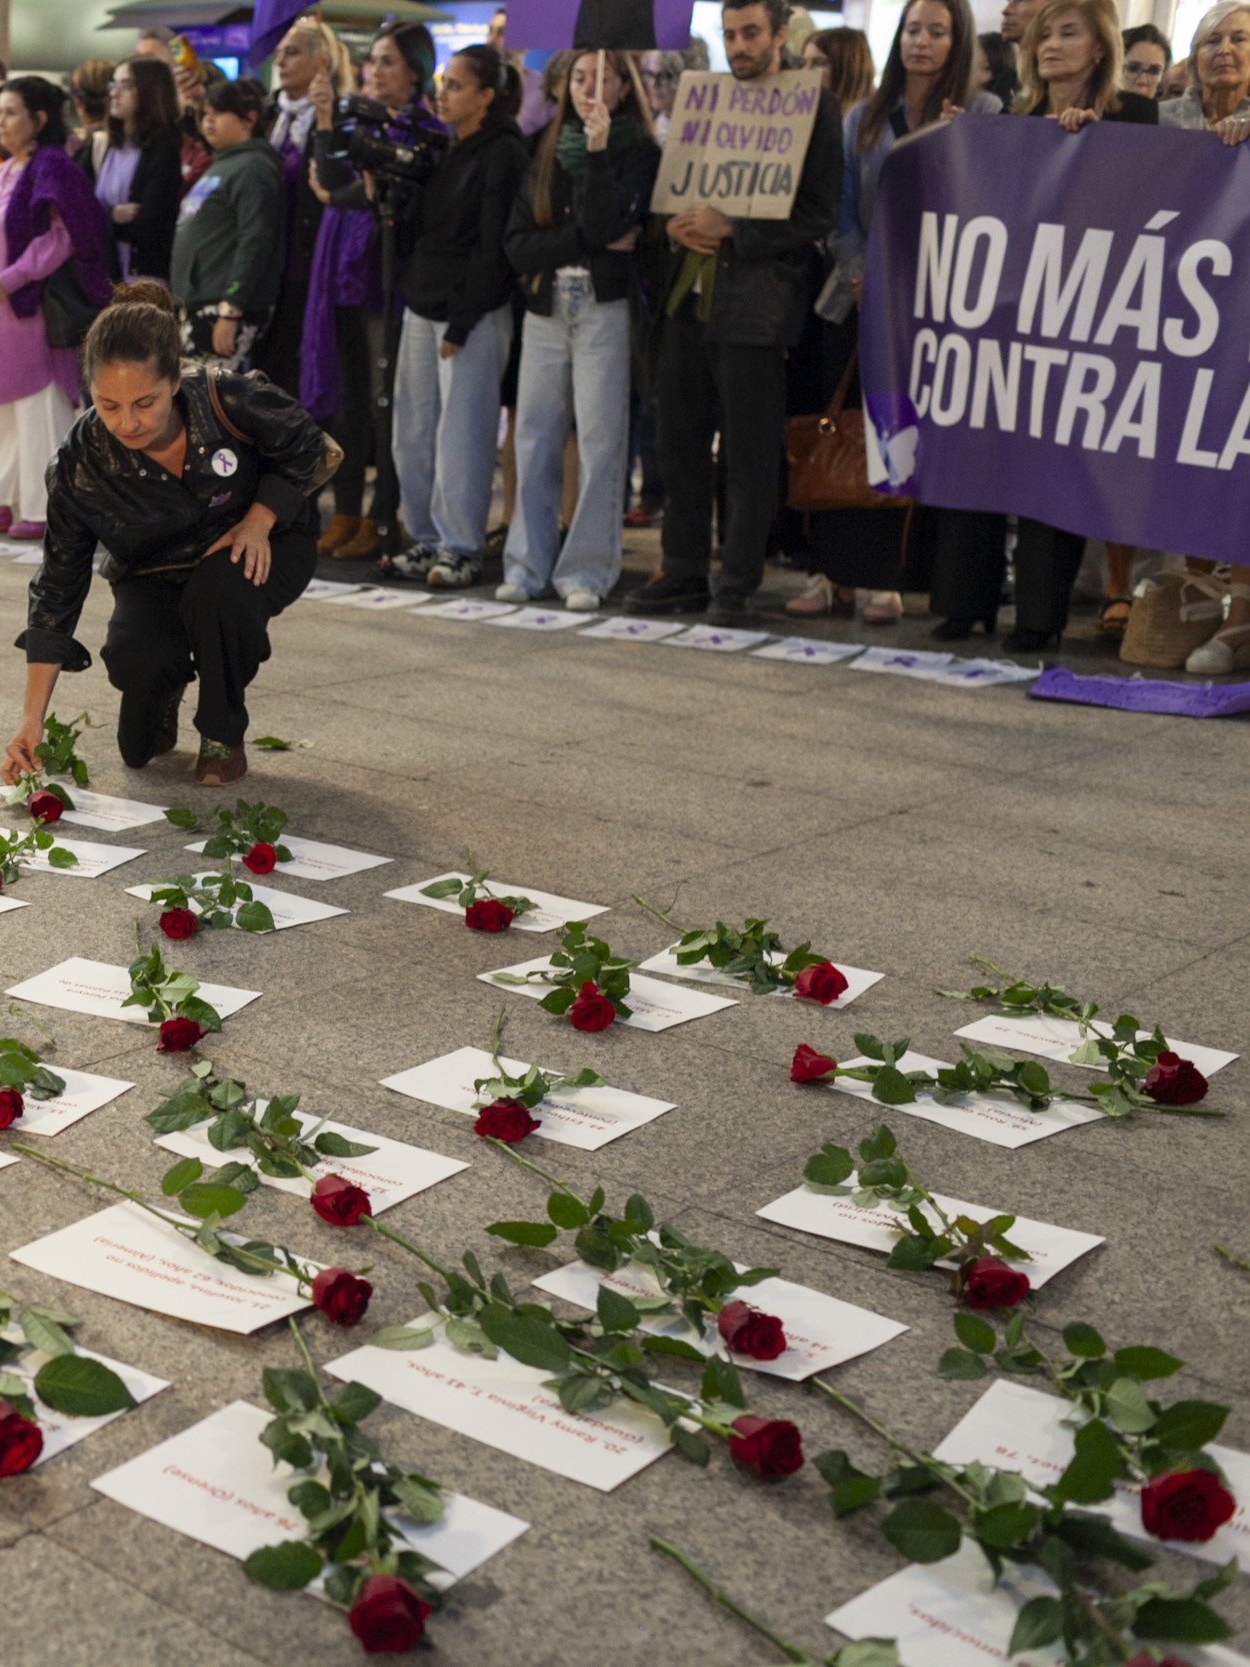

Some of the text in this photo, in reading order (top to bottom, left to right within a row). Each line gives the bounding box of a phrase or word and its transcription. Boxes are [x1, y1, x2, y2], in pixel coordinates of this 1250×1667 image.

[685, 82, 817, 117] NI PERDÓN
[680, 119, 793, 154] NI OLVIDO
[670, 160, 792, 198] JUSTICIA
[914, 209, 1233, 357] NO MÁS
[909, 327, 1162, 460] CONTRA
[105, 1254, 124, 1265] no
[125, 1260, 186, 1288] apellidos
[190, 1283, 244, 1308] Josefina,
[483, 1391, 547, 1424] Virginia
[601, 1439, 628, 1456] 20.
[161, 1464, 299, 1534] 76 años (Orense)
